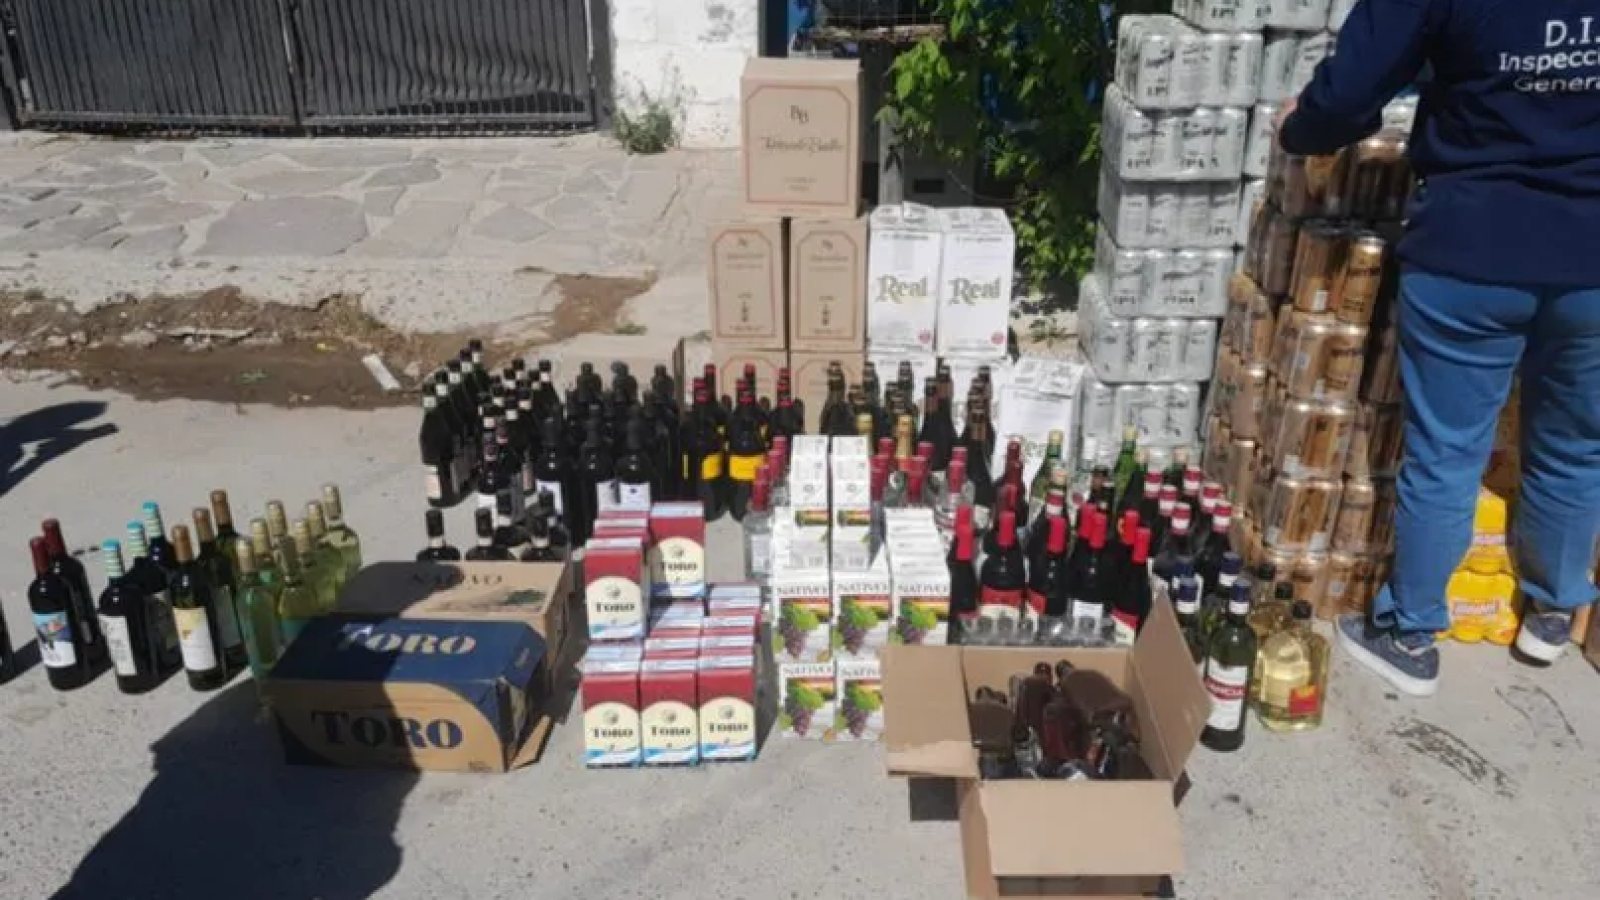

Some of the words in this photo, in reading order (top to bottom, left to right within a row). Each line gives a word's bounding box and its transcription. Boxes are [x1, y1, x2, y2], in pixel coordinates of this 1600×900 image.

[874, 274, 928, 304] Real
[947, 277, 1001, 306] Real
[310, 711, 463, 750] TORO
